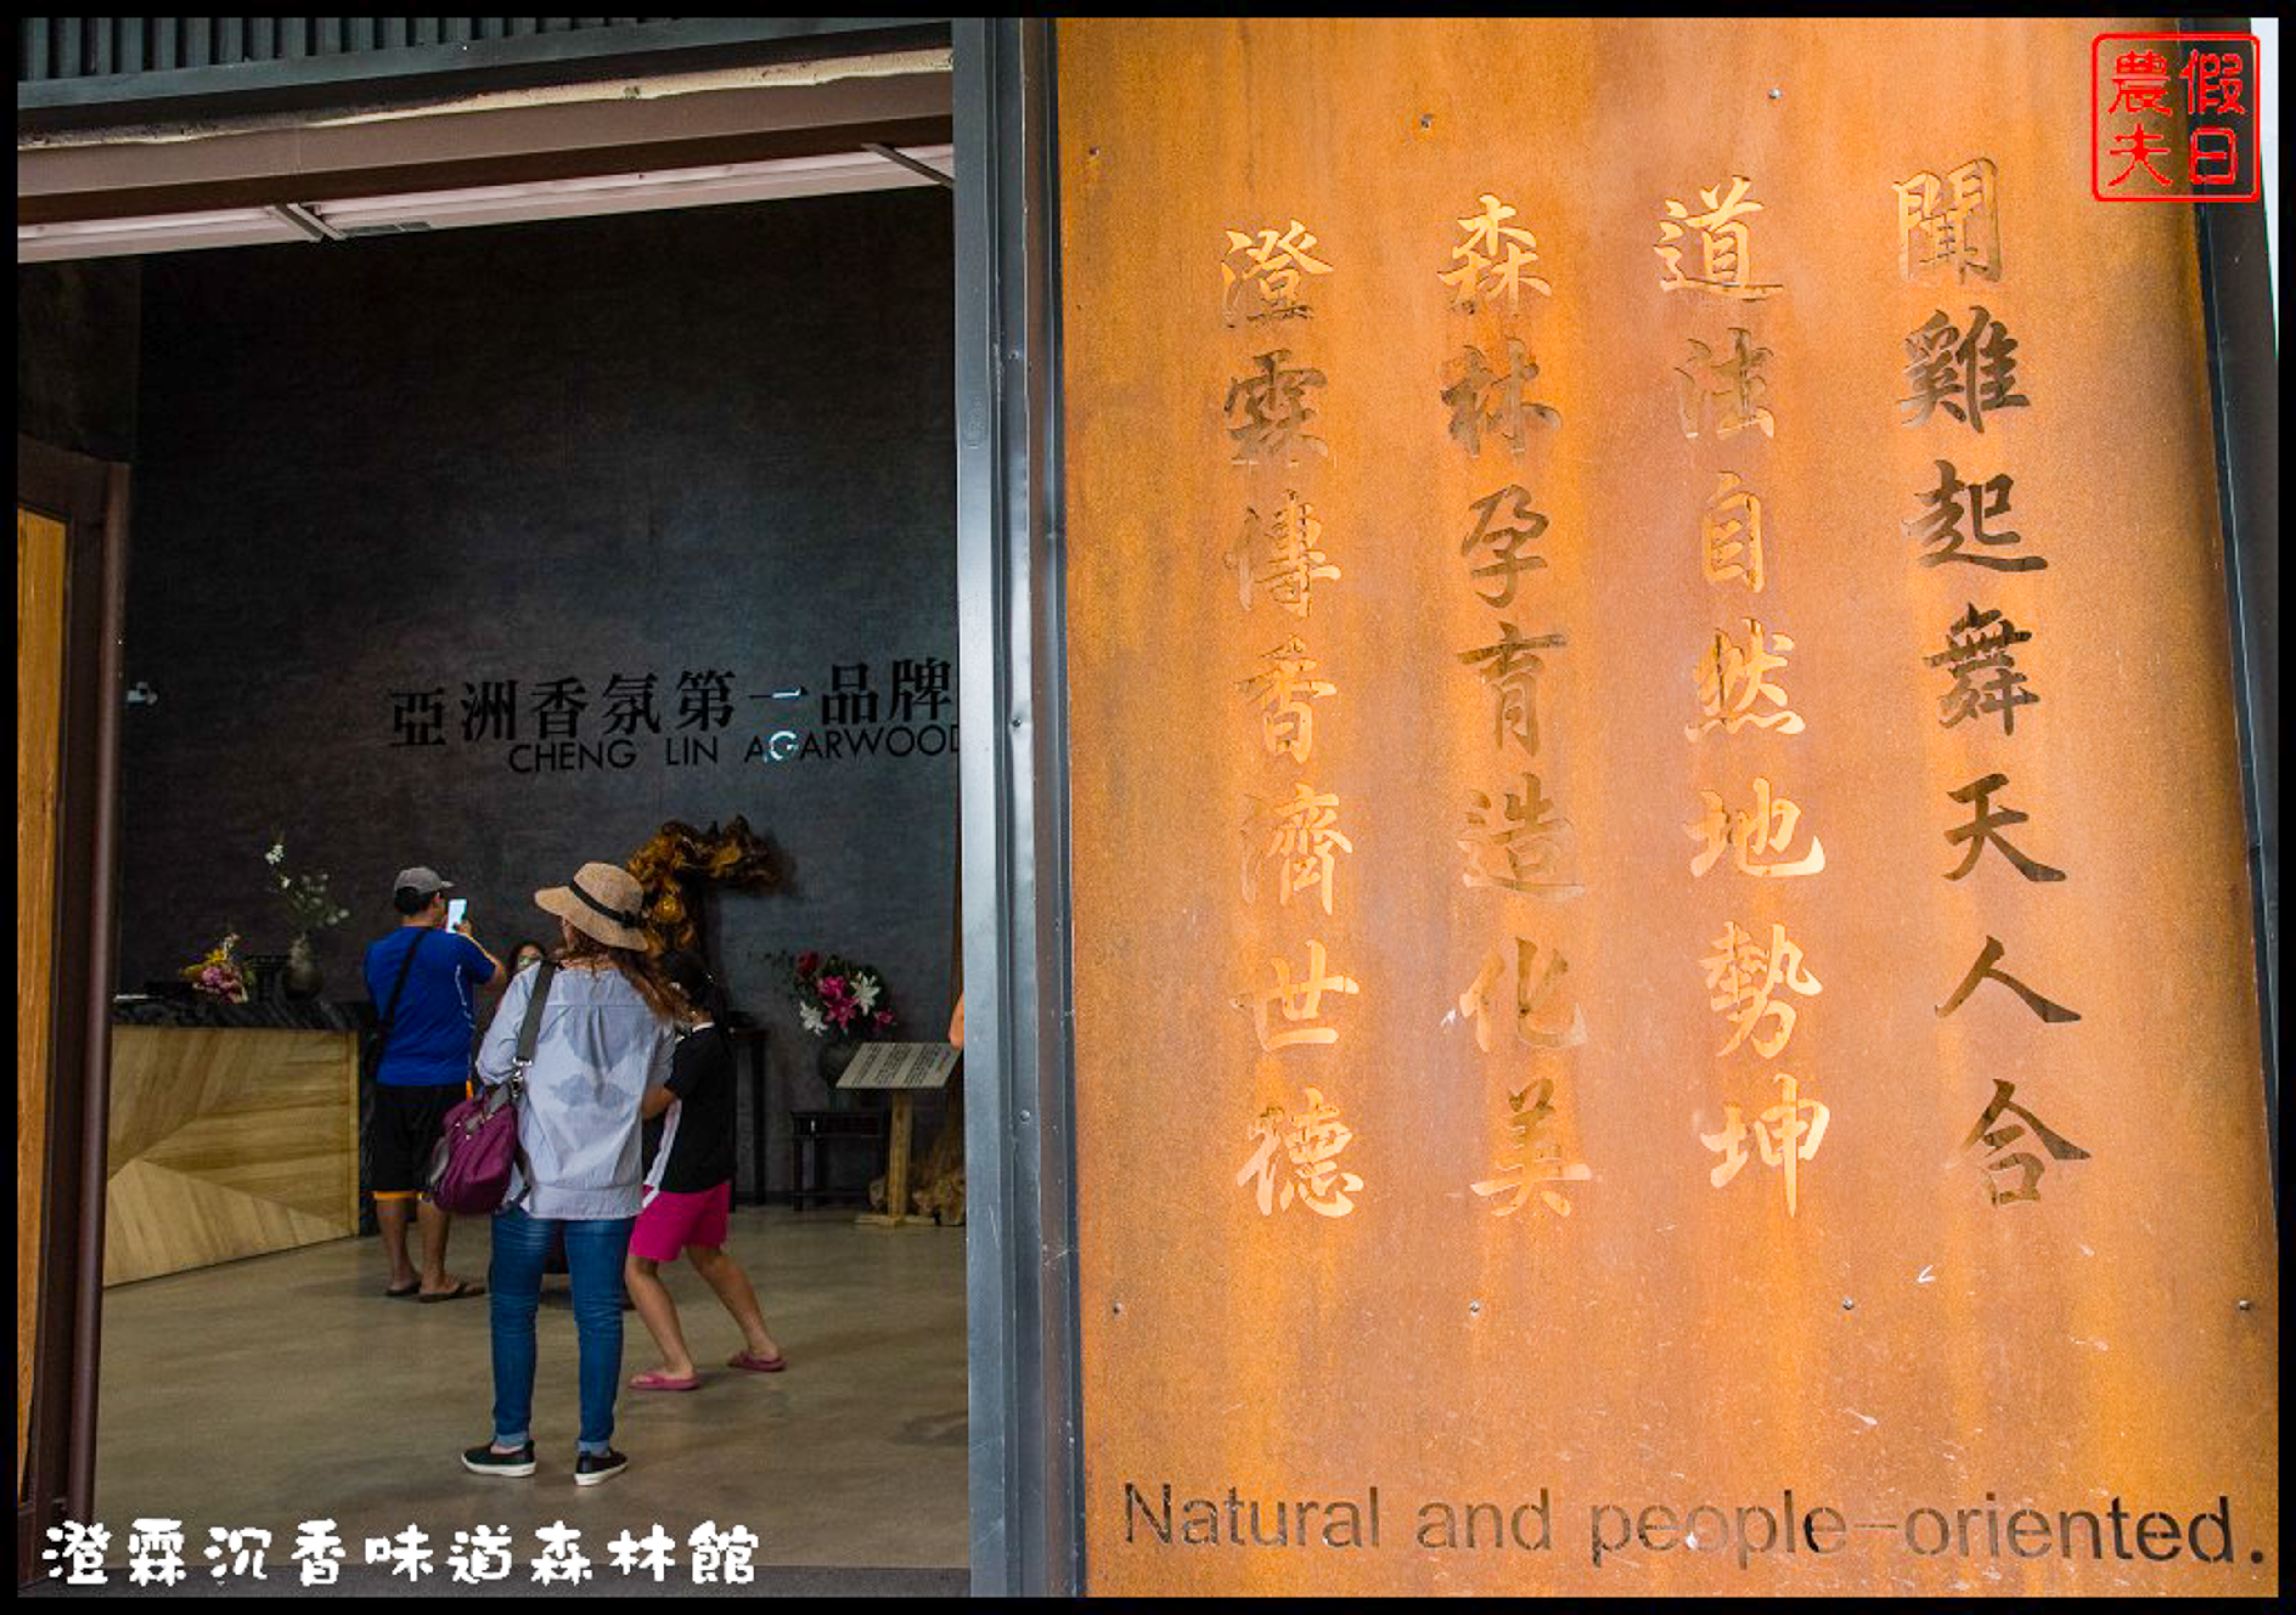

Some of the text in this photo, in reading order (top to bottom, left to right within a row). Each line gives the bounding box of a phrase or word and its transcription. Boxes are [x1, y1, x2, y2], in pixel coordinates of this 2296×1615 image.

[389, 657, 953, 748] 亞洲香氛第一品牌
[508, 739, 636, 773] CHENG
[666, 736, 718, 766] LIN
[1221, 220, 1365, 1218] 澄霖傳香濟世德
[1437, 194, 1592, 1218] 森林孕育造化美
[1653, 175, 1830, 1218] 道法自然地勢坤
[1893, 157, 2092, 1206] 聞雞起舞天人合
[1124, 1482, 1379, 1548] Natural
[1416, 1487, 1552, 1550] and
